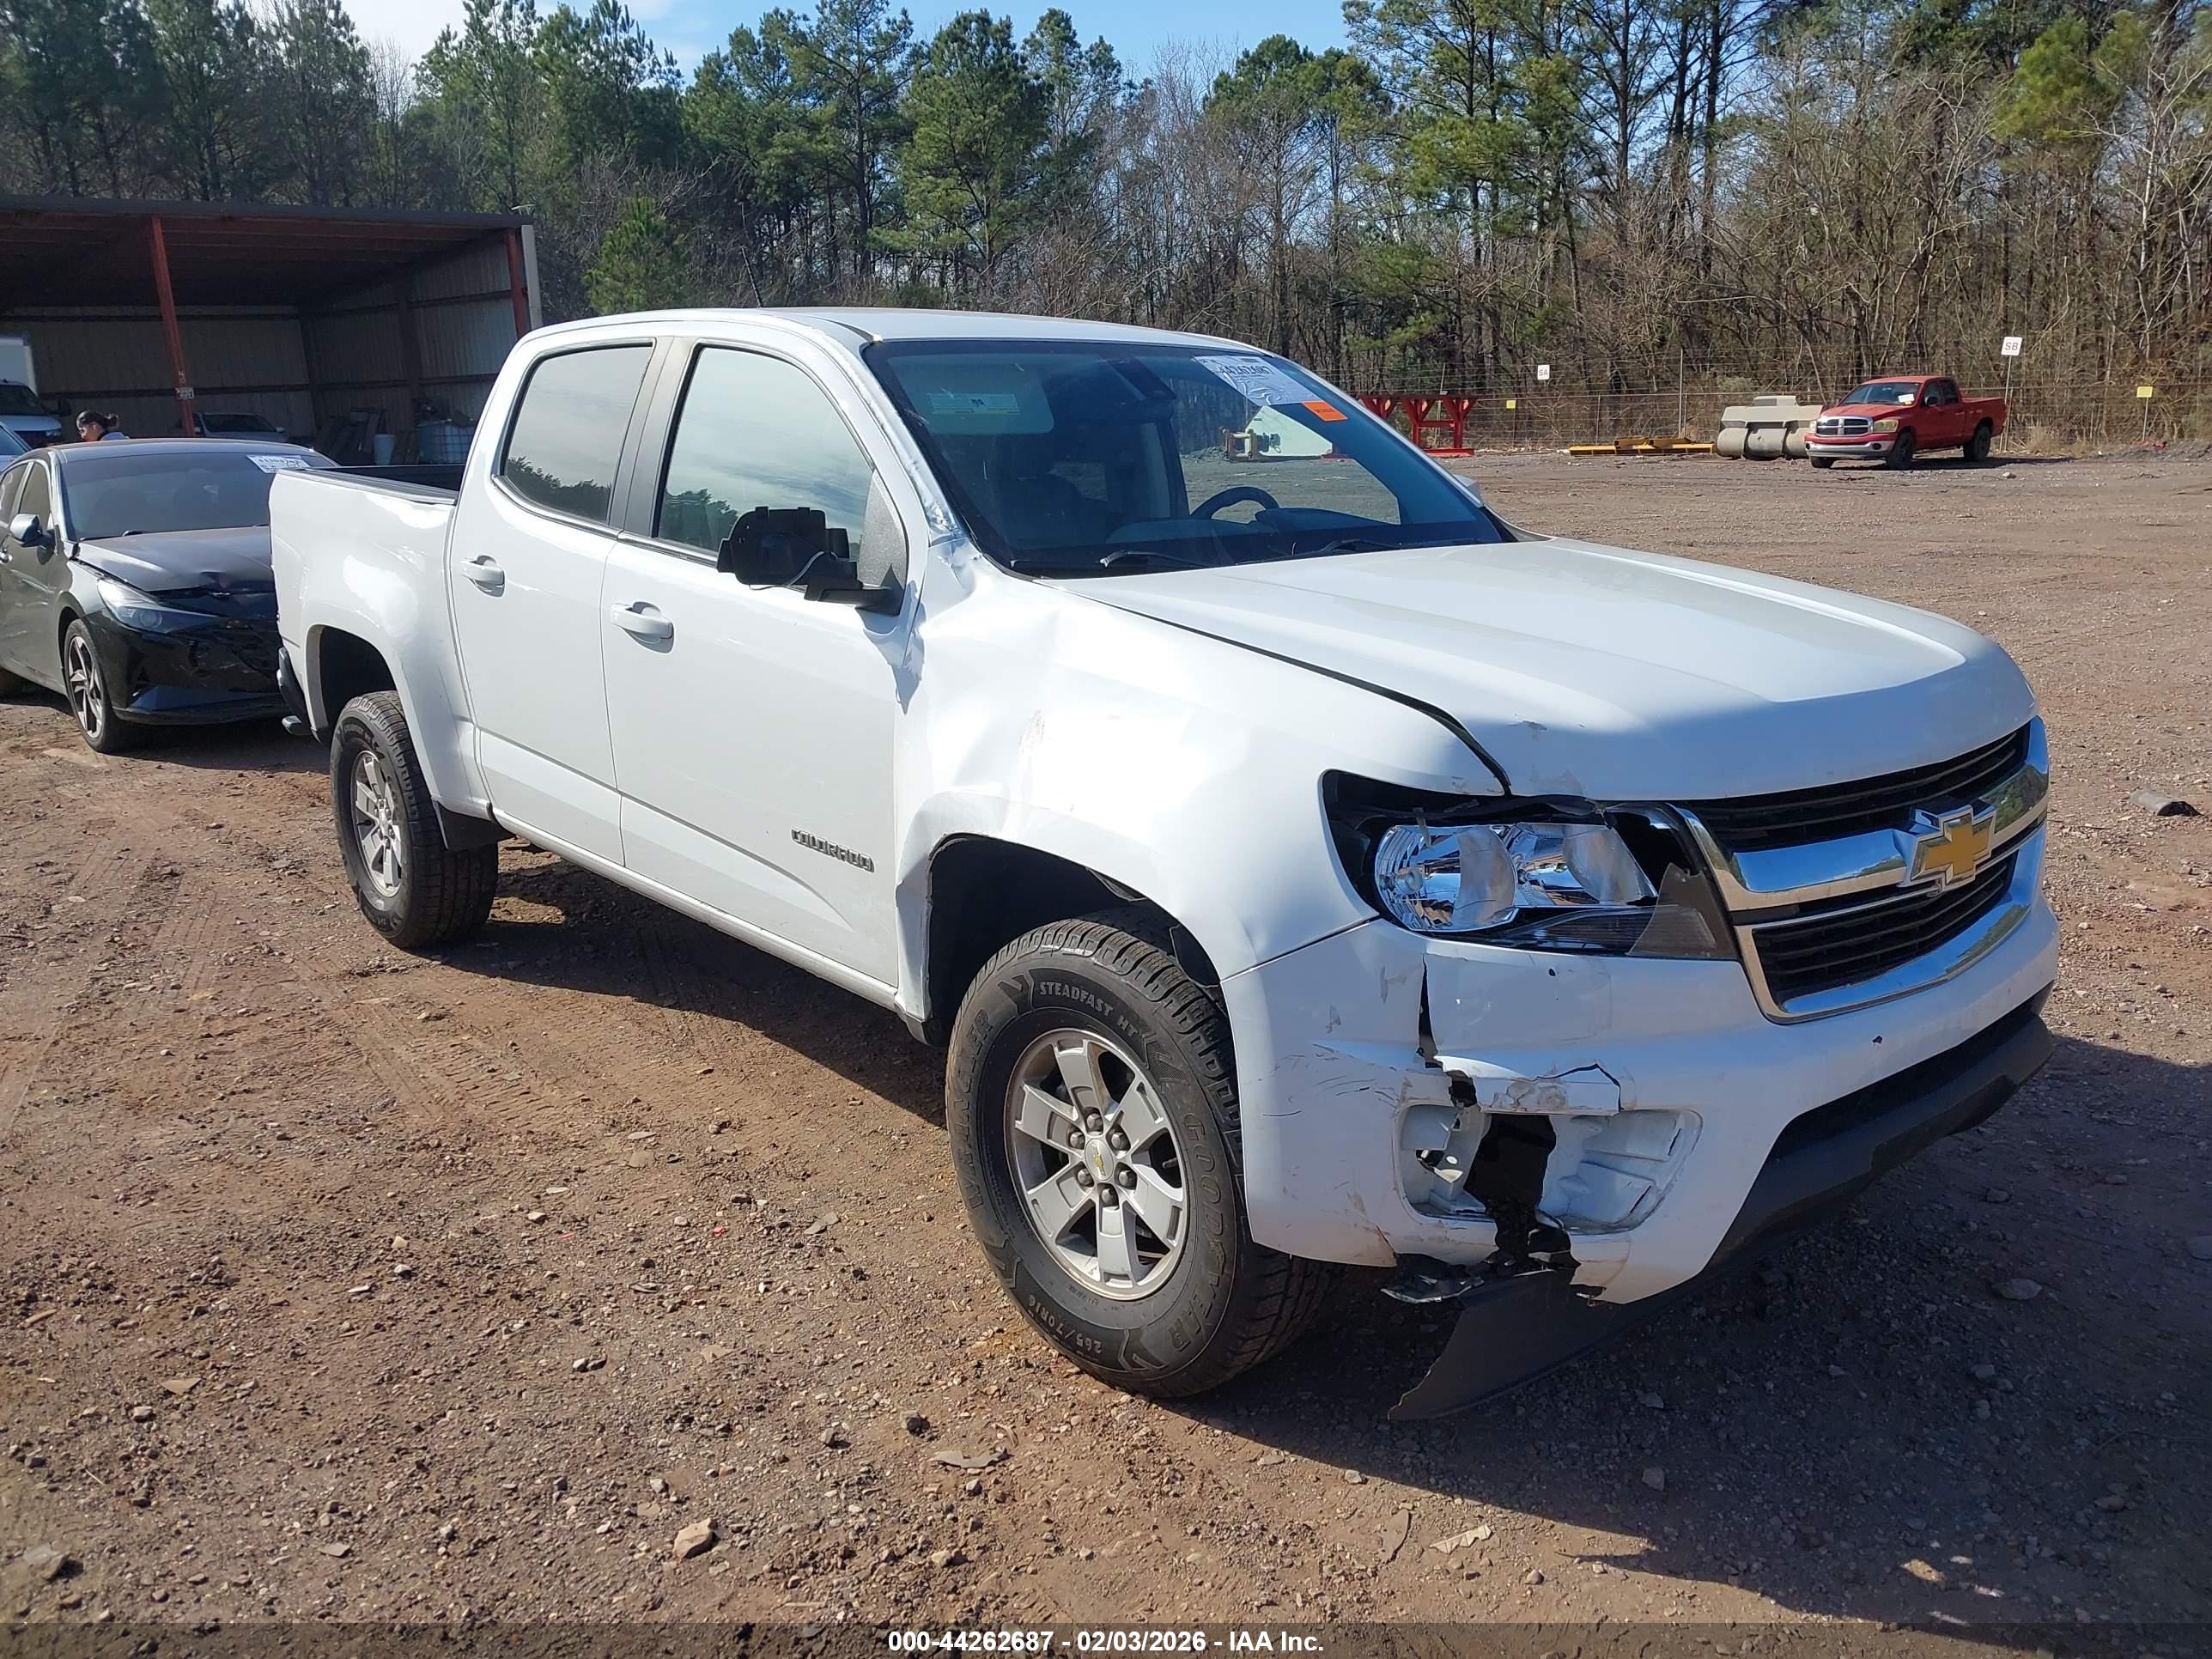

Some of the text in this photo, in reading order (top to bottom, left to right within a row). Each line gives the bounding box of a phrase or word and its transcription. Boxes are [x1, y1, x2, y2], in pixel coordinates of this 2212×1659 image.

[2004, 342, 2019, 350] SB
[790, 828, 875, 873] COLORADO
[1039, 981, 1139, 1036] STEADFAST HT
[953, 1007, 994, 1211] WRANGLER
[1168, 1112, 1226, 1353] GOODYEAR
[1028, 1294, 1103, 1354] 265/70R16
